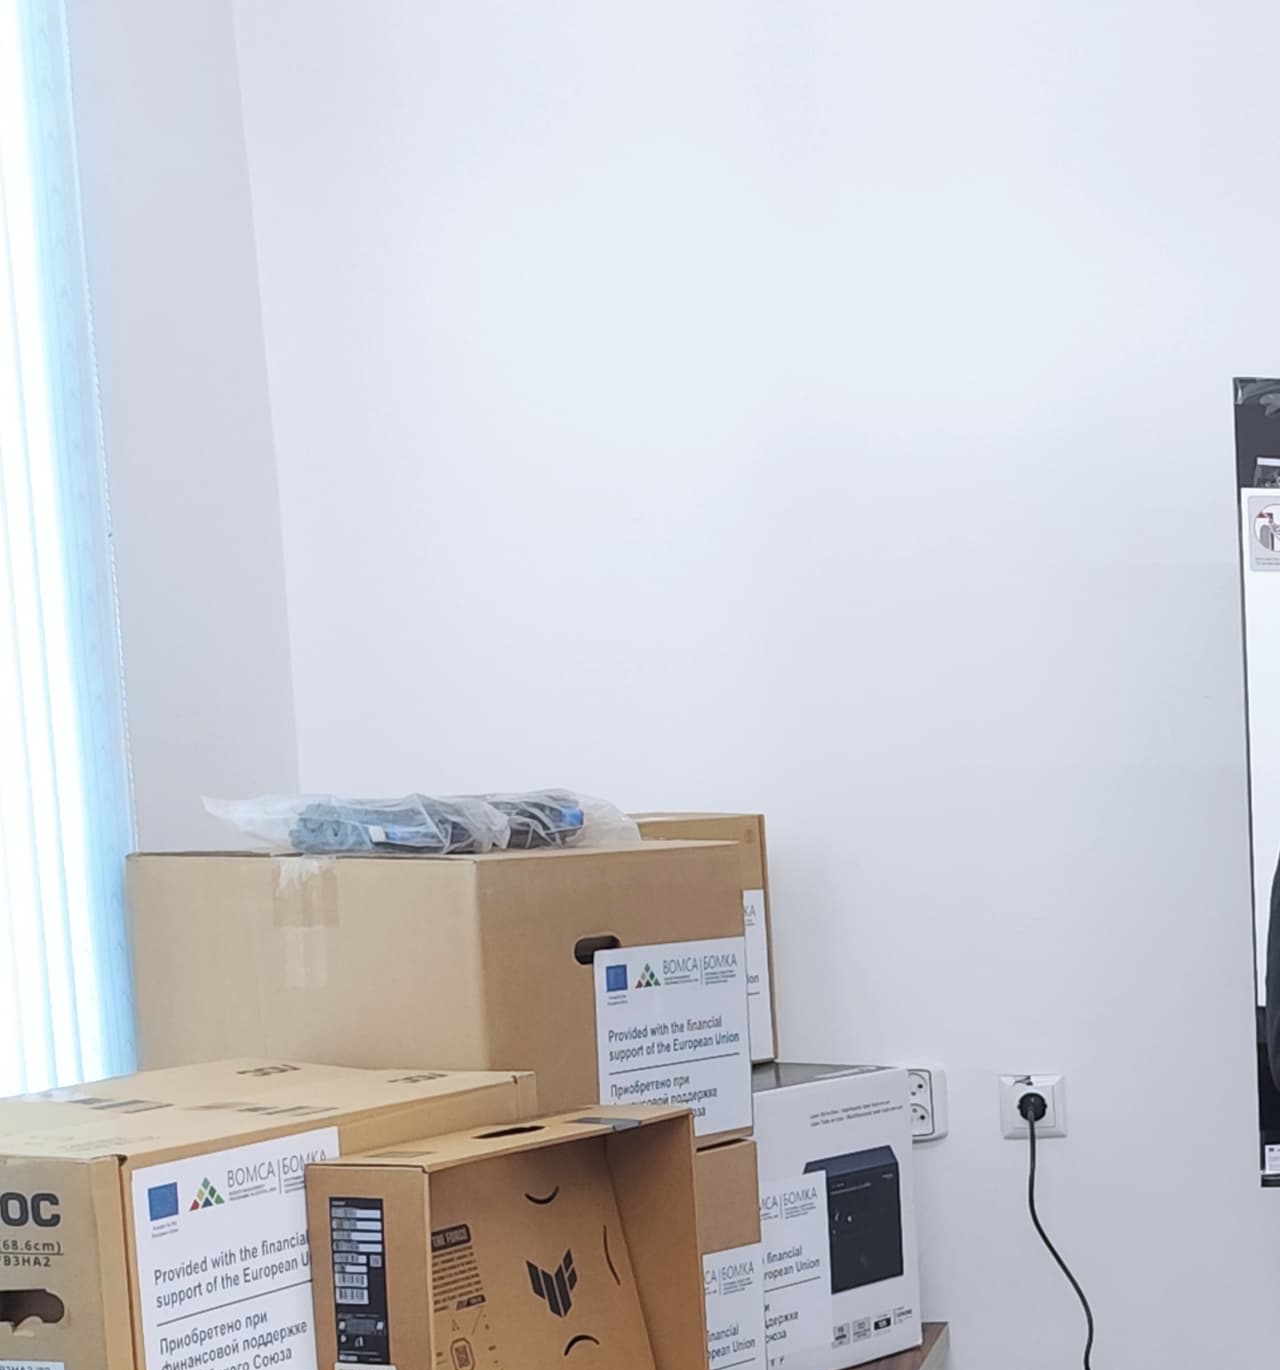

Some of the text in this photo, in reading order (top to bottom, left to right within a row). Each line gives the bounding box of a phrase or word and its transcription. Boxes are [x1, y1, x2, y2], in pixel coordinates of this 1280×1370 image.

[663, 957, 698, 975] BOMCA
[704, 953, 737, 970] БОМКА
[608, 1016, 722, 1042] Provided with the financial
[609, 1032, 739, 1062] support of the European Union
[227, 1161, 275, 1188] BOMCA
[783, 1187, 818, 1207] БОМКА
[0, 1192, 60, 1227] OC
[154, 1230, 310, 1285] Provided with the financial
[767, 1246, 802, 1264] financial
[796, 1258, 820, 1273] Union
[157, 1281, 202, 1308] support
[206, 1276, 218, 1296] of
[222, 1273, 240, 1289] the
[243, 1258, 298, 1283] European
[722, 1261, 754, 1281] БОМКА
[159, 1311, 267, 1355] Приобретено при
[243, 1321, 308, 1354] поддержке
[733, 1338, 755, 1353] Union
[253, 1347, 293, 1370] Союза
